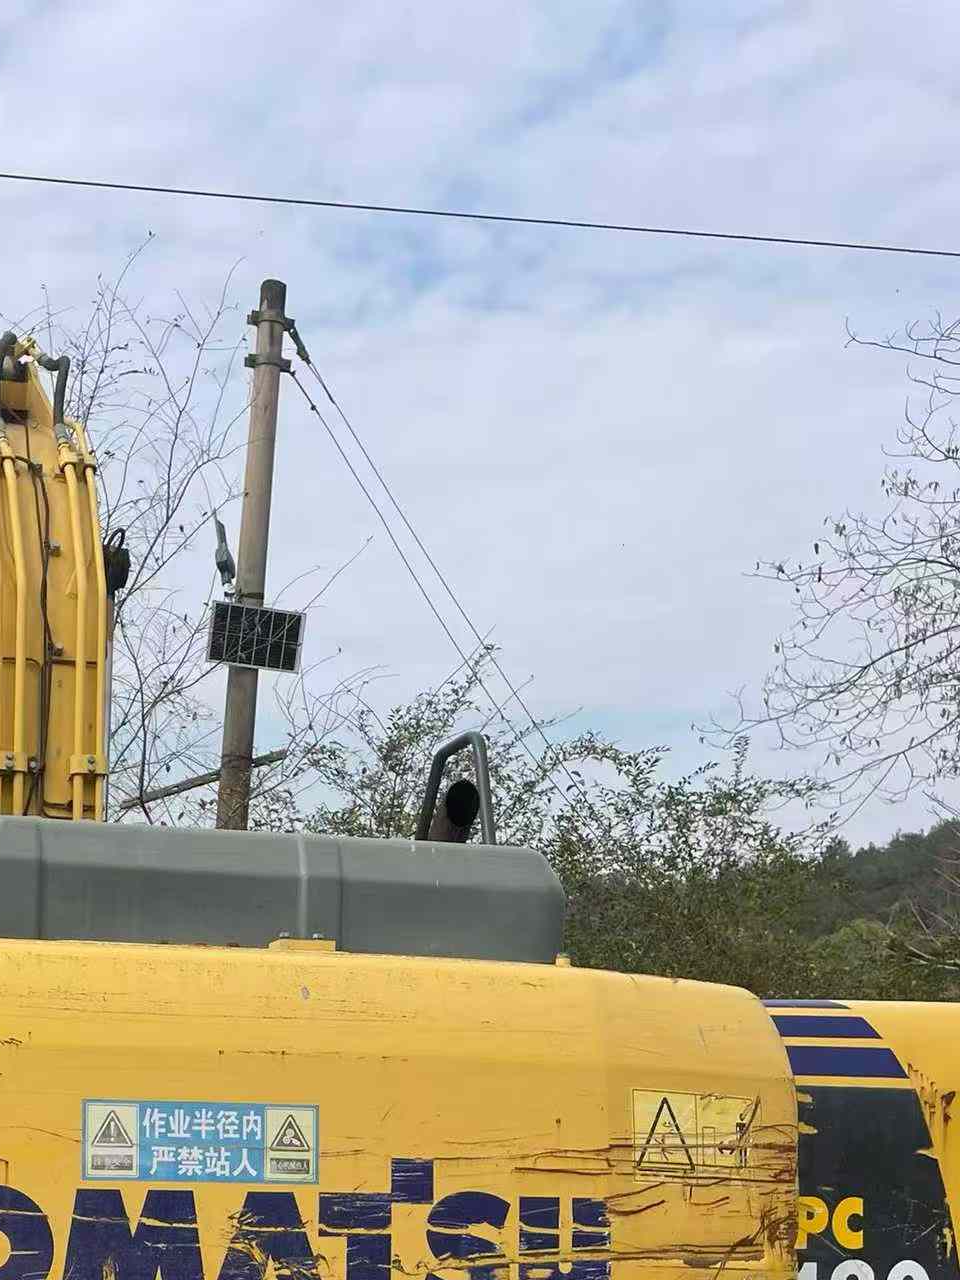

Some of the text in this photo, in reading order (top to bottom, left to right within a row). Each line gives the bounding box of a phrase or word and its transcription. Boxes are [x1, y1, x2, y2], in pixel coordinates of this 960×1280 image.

[142, 1107, 262, 1141] 作业半径内
[149, 1145, 258, 1177] 严禁站人
[794, 1196, 864, 1250] PC
